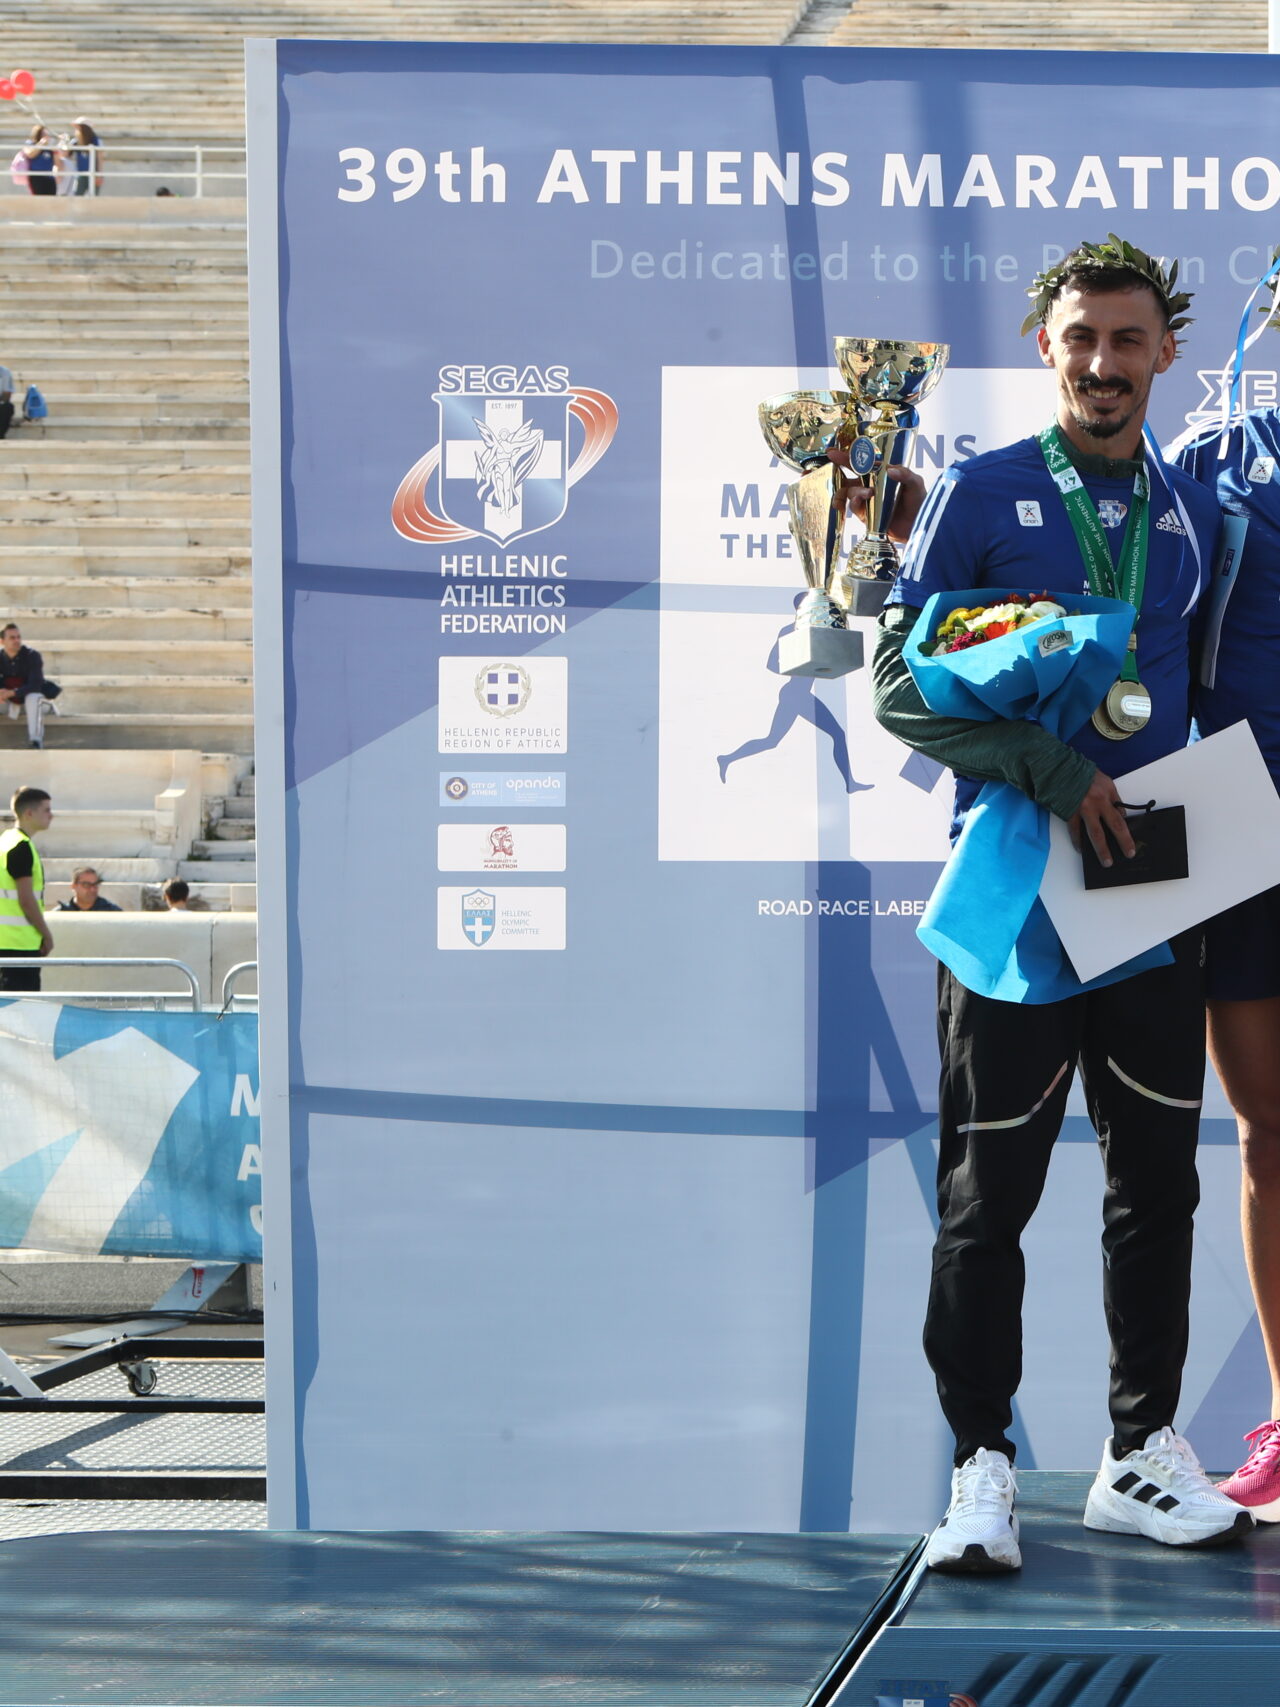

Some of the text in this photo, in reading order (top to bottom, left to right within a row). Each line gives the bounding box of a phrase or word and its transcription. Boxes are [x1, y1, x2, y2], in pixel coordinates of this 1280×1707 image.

[337, 146, 508, 203] 39th
[536, 148, 851, 207] ATHENS
[590, 238, 849, 282] Dedicated
[869, 244, 919, 283] to
[940, 241, 1019, 283] the
[439, 365, 569, 394] SEGAS
[1074, 495, 1097, 532] AUTHENTIC
[1156, 522, 1187, 536] adidas
[720, 533, 792, 559] THE
[440, 555, 568, 577] HELLENIC
[440, 584, 566, 607] ATHLETICS
[440, 614, 567, 634] FEDERATION
[444, 728, 561, 737] HELLENIC REPUBLIC
[444, 739, 561, 748] REGION OF ATTICA
[506, 776, 561, 791] opanda
[758, 900, 812, 915] ROAD
[818, 900, 870, 915] RACE
